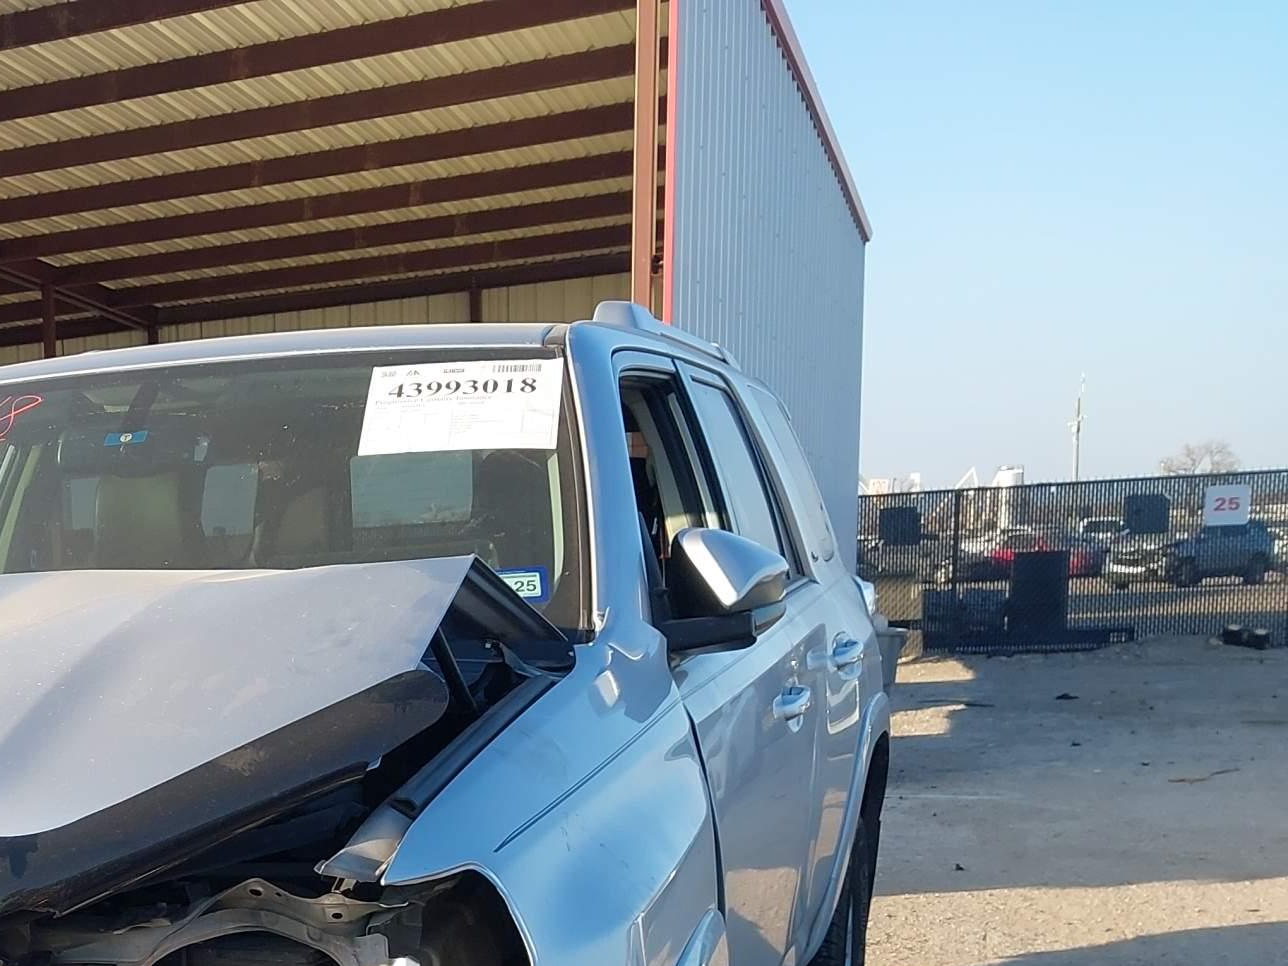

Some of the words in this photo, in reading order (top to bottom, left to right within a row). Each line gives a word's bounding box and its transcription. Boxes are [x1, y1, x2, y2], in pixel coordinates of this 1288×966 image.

[387, 377, 537, 399] 43993018
[1213, 496, 1241, 512] 25
[514, 579, 537, 592] 25
